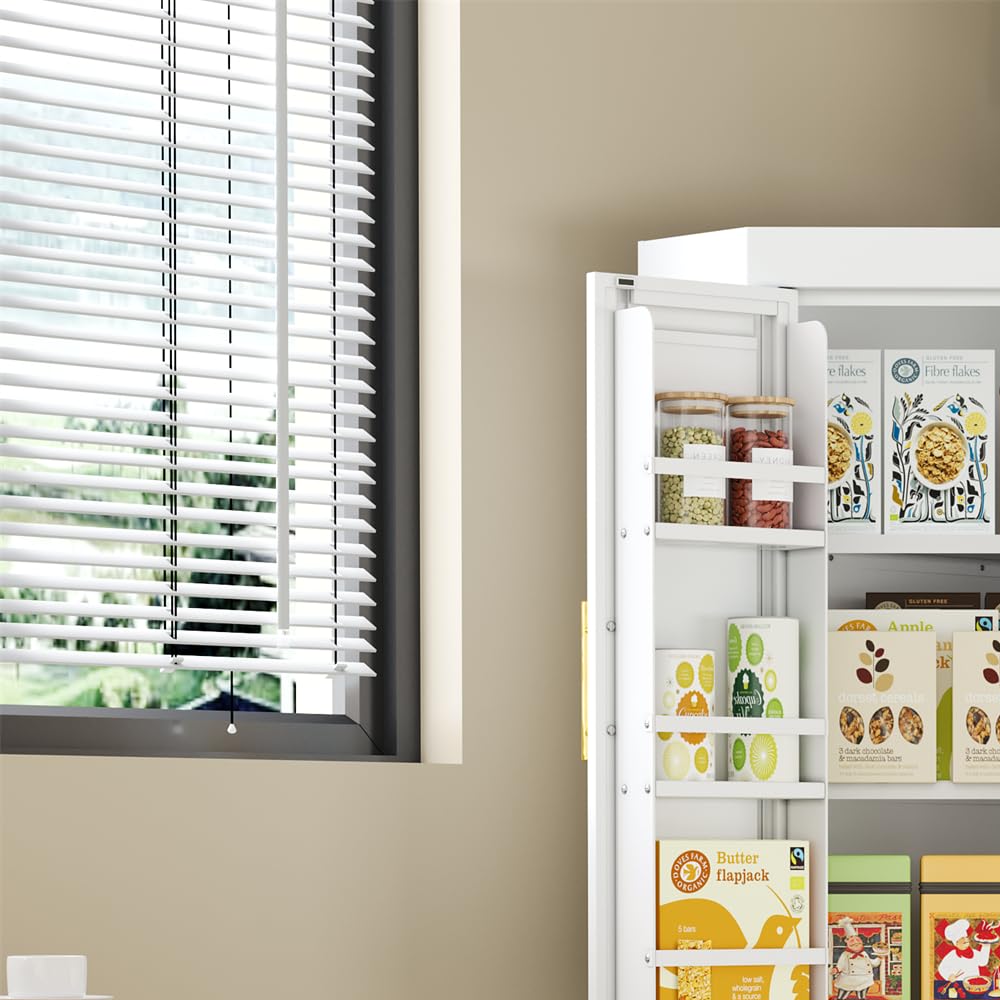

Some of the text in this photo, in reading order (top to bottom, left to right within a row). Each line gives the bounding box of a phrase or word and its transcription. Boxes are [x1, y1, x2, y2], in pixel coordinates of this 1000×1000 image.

[838, 365, 866, 377] flakes
[925, 365, 981, 377] Fibre flakes
[716, 851, 759, 864] Butter
[673, 852, 709, 879] DOVES FARM
[676, 872, 709, 892] ORGANIC
[716, 869, 770, 885] flapjack
[732, 984, 762, 993] wholegrain
